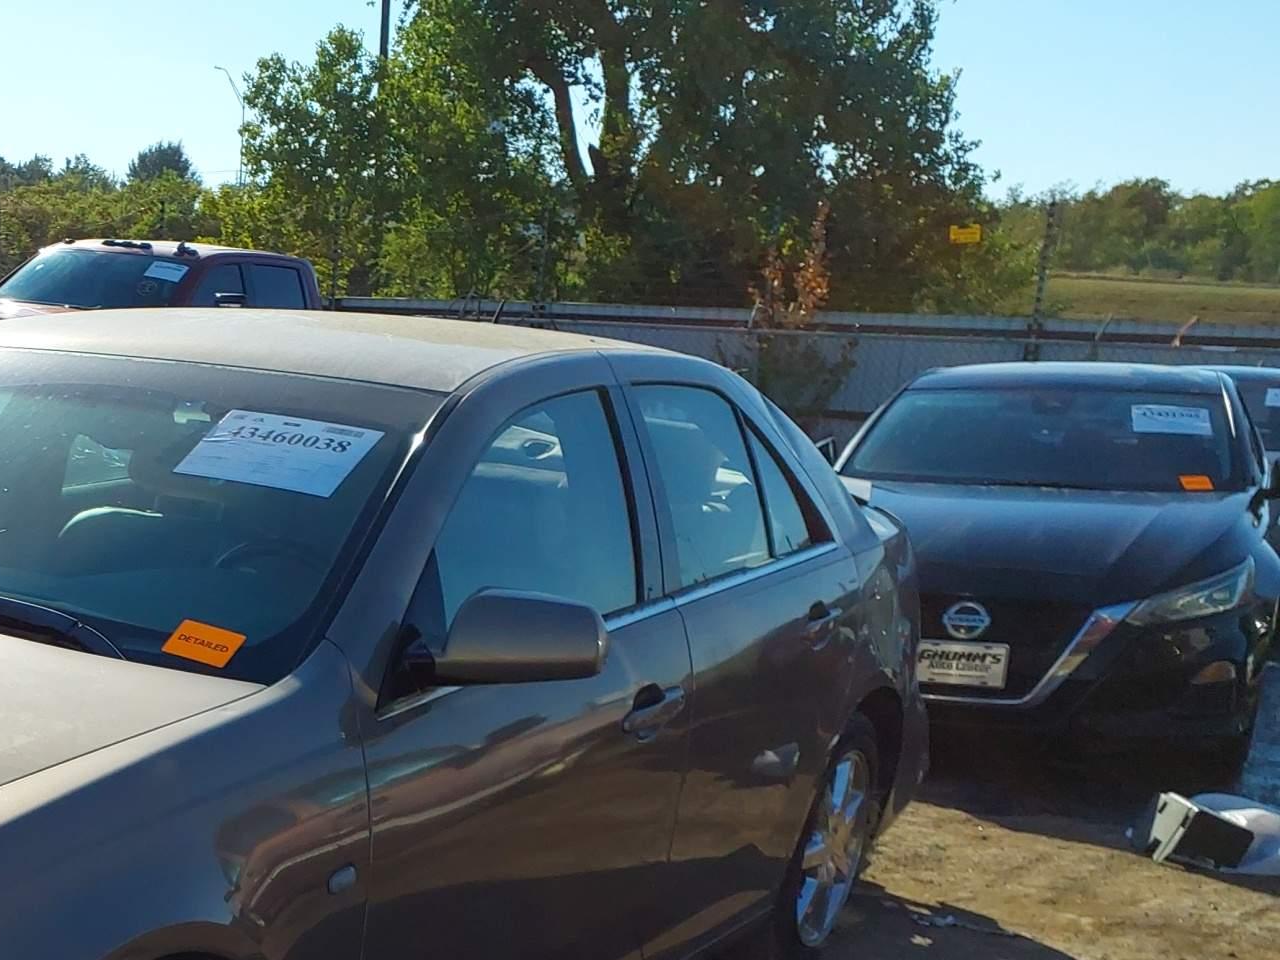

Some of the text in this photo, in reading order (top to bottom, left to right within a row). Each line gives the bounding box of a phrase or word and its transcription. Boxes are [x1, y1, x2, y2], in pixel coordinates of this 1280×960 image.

[230, 426, 352, 454] 43460038
[178, 633, 229, 653] DETAILED
[928, 661, 953, 670] Auto
